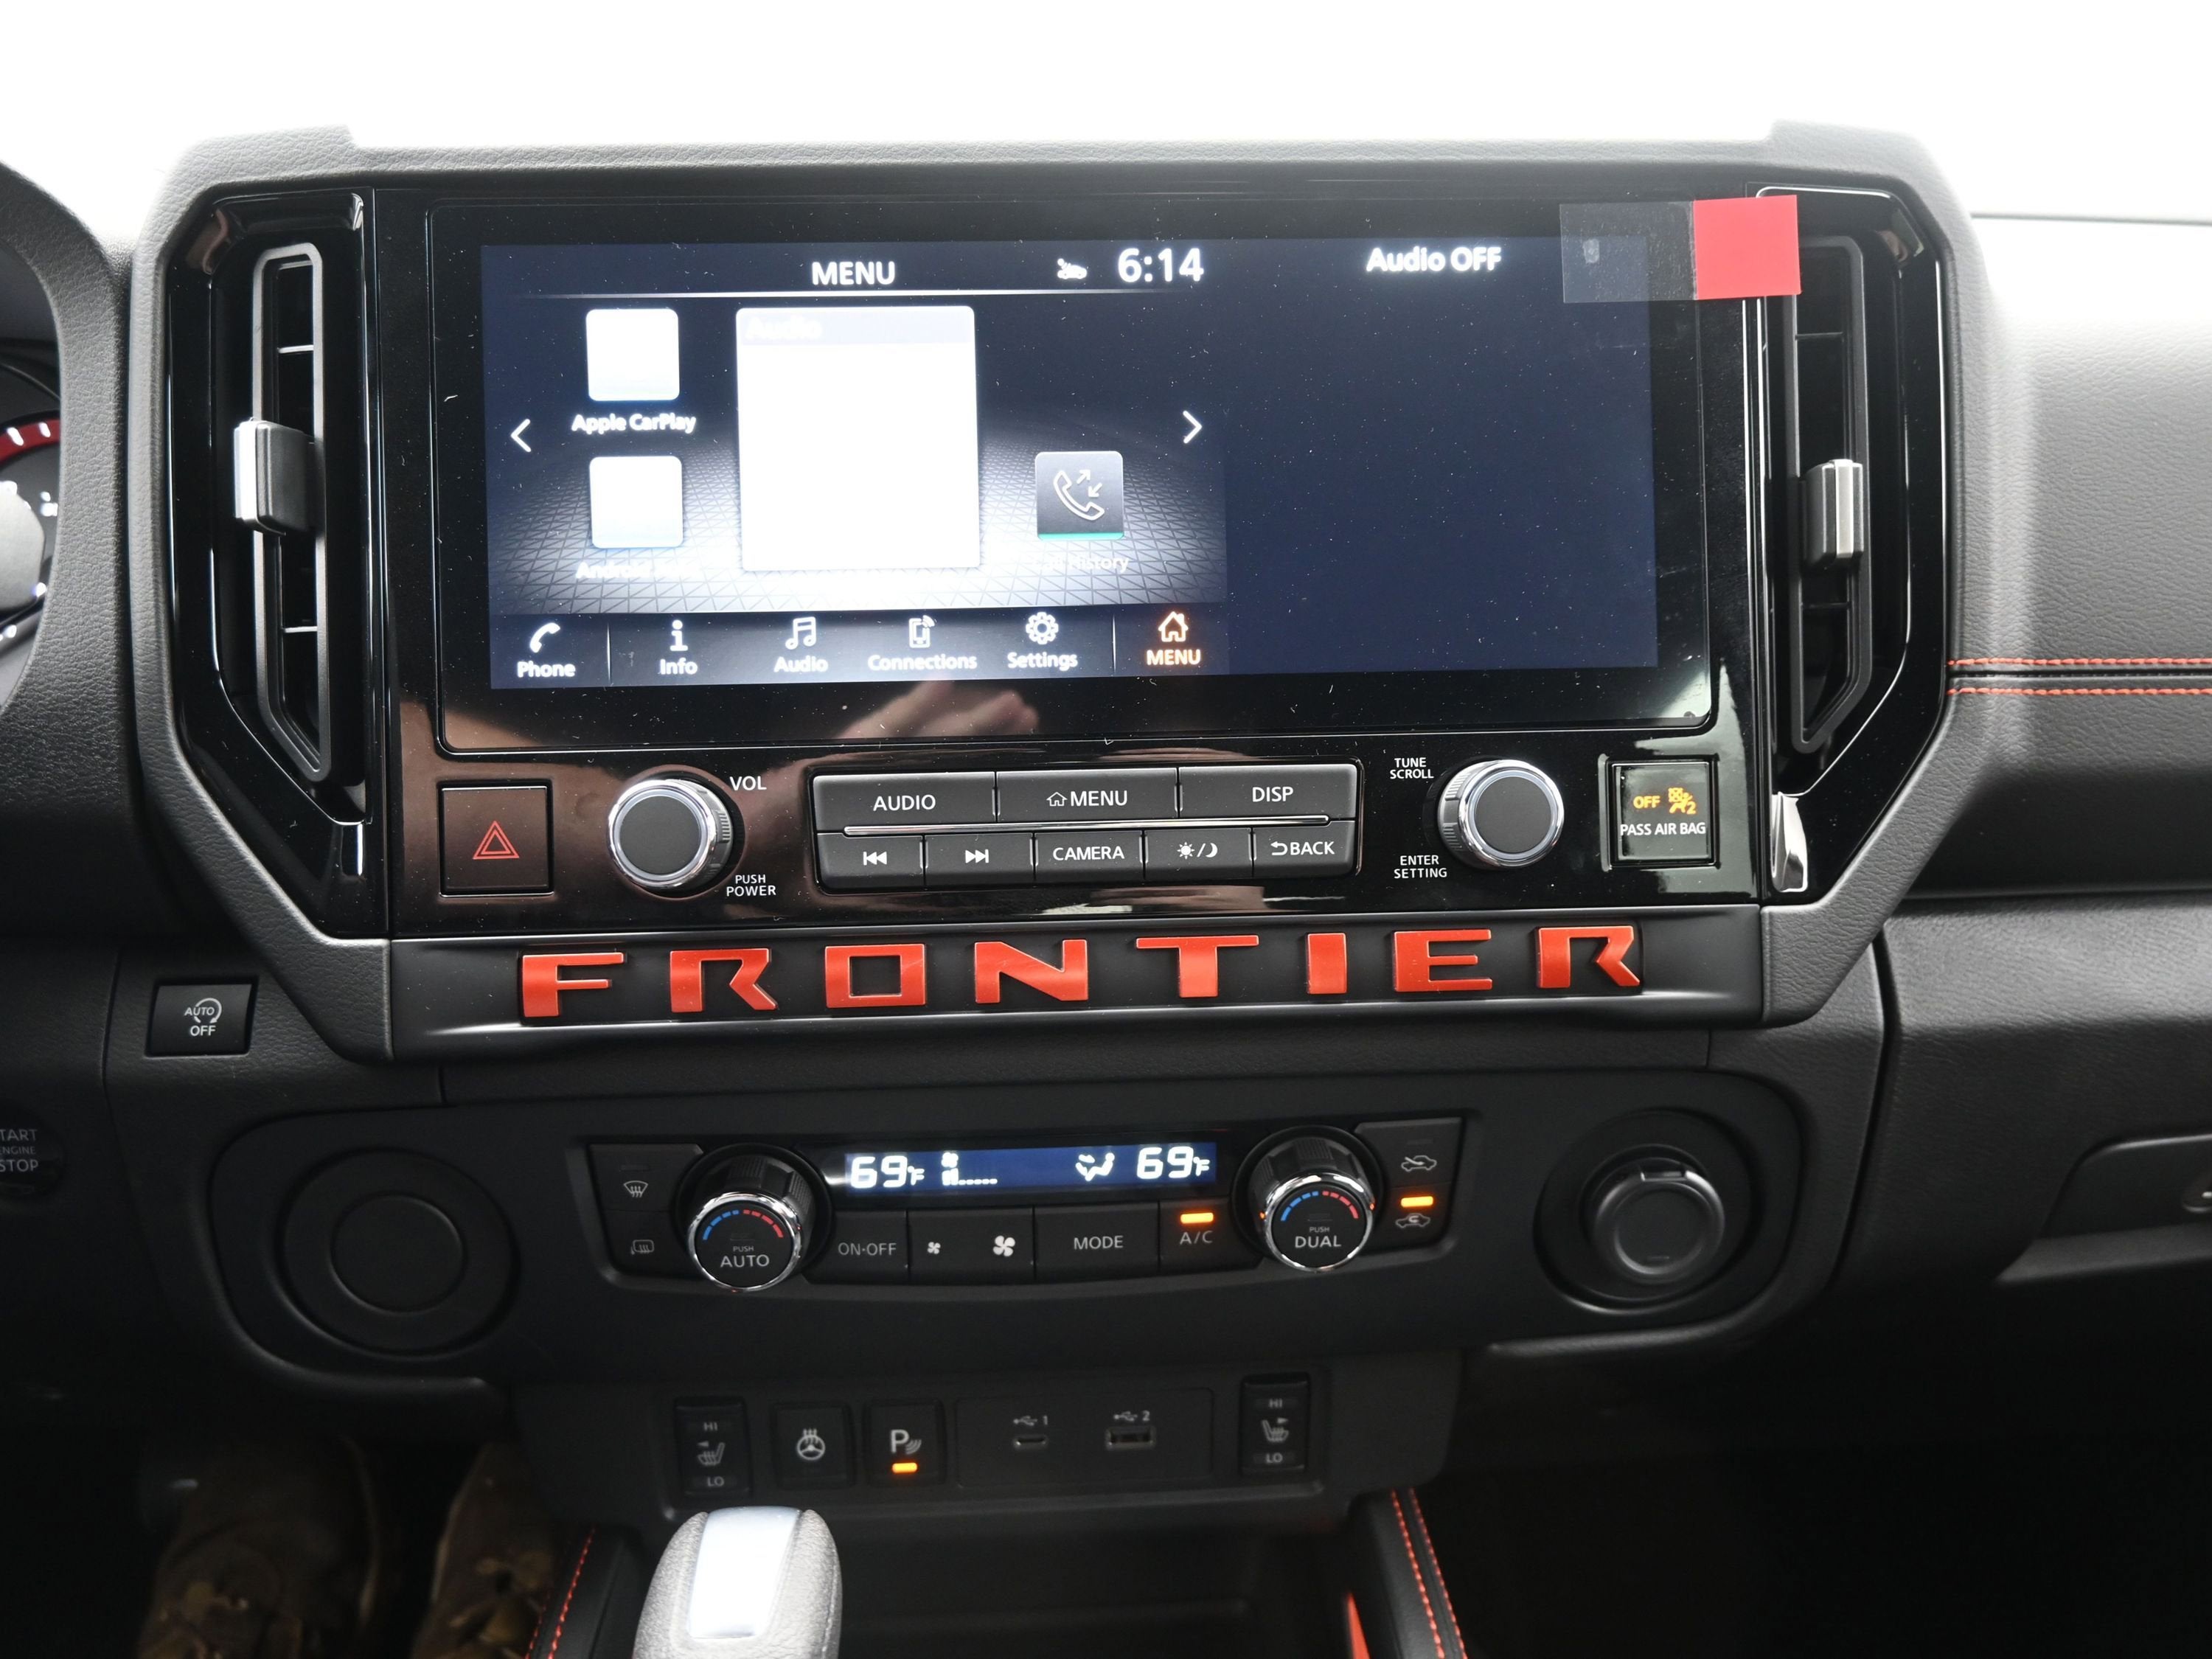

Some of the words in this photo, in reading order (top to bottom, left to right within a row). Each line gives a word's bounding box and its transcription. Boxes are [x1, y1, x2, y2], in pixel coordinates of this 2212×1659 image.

[1117, 248, 1205, 283] 6:14
[1366, 247, 1445, 272] Audio
[1451, 247, 1502, 271] OFF
[811, 261, 896, 285] MENU
[571, 413, 627, 434] Apple
[630, 411, 696, 434] CarPlay
[774, 655, 829, 672] Audio
[867, 653, 978, 671] Connections
[1007, 651, 1078, 672] Settings
[1147, 649, 1201, 666] MENU
[517, 661, 576, 678] Phone
[659, 659, 698, 676] Info
[1394, 757, 1427, 768] TUNE
[1390, 768, 1434, 779] SCROLL
[729, 776, 768, 791] VOL
[1070, 790, 1128, 808] MENU
[1252, 786, 1294, 803] DISP
[873, 794, 936, 811] AUDIO
[1633, 796, 1660, 810] OFF
[1620, 824, 1652, 836] PASS
[1654, 823, 1677, 835] AIR
[1680, 822, 1706, 835] BAG
[1053, 845, 1125, 862] CAMERA
[1289, 841, 1335, 857] BACK
[1400, 855, 1439, 866] ENTER
[734, 874, 767, 885] PUSH
[1394, 866, 1447, 880] SETTING
[726, 885, 776, 897] POWER
[521, 925, 1641, 1018] FRONTIER
[184, 1006, 215, 1018] AUTO
[189, 1025, 216, 1037] OFF
[0, 1159, 38, 1172] STOP
[1309, 1225, 1330, 1234] PUSH
[1074, 1234, 1124, 1250] MODE
[1180, 1230, 1213, 1245] A/C
[1294, 1234, 1342, 1248] DUAL
[732, 1245, 754, 1253] PUSH
[720, 1253, 770, 1268] AUTO
[1269, 1398, 1283, 1408] HI
[703, 1422, 718, 1432] HI
[1266, 1453, 1283, 1464] LO
[707, 1476, 725, 1487] LO
